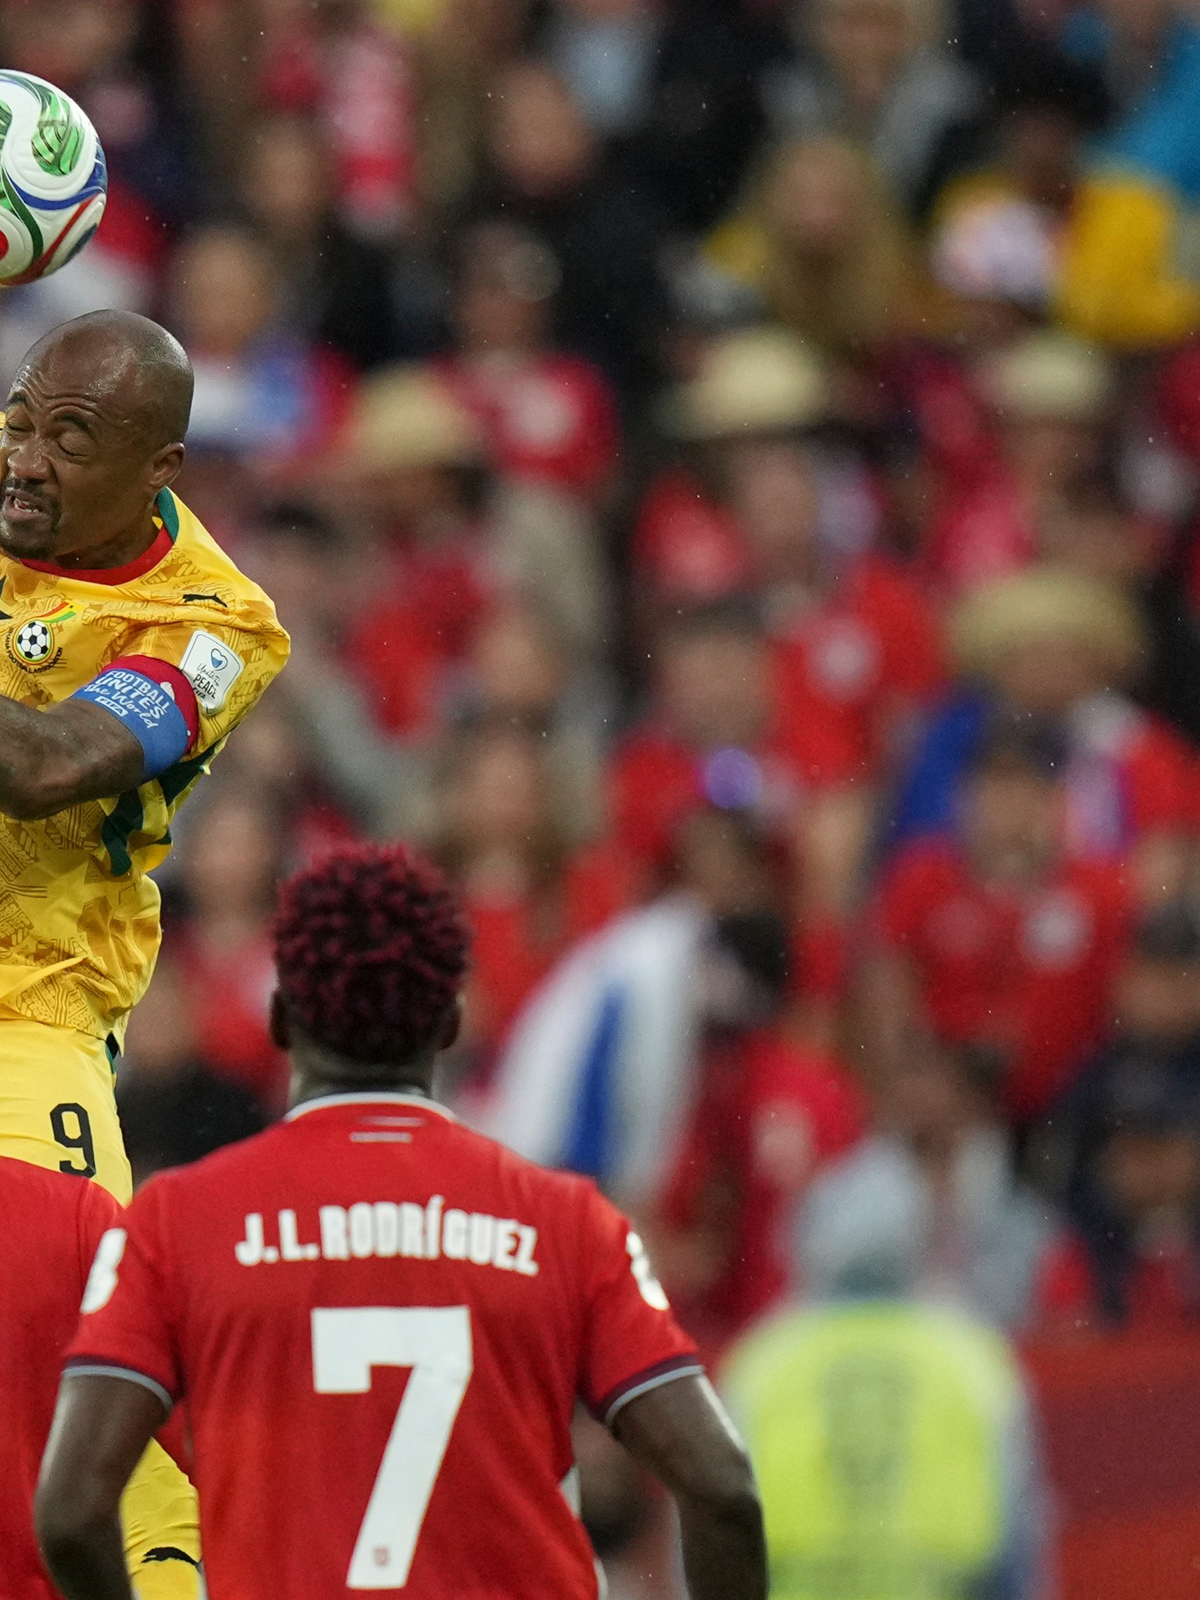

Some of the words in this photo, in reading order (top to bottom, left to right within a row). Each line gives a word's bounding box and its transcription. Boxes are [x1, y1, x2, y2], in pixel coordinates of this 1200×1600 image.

[84, 683, 111, 696] the
[111, 691, 159, 729] World
[95, 676, 165, 719] UNITES
[99, 697, 123, 715] FIFA
[103, 670, 170, 713] FOOTBALL
[193, 674, 218, 699] PEACE
[49, 1102, 97, 1178] 9
[234, 1194, 539, 1277] J.L.RODRÍGUEZ
[311, 1305, 473, 1590] 7
